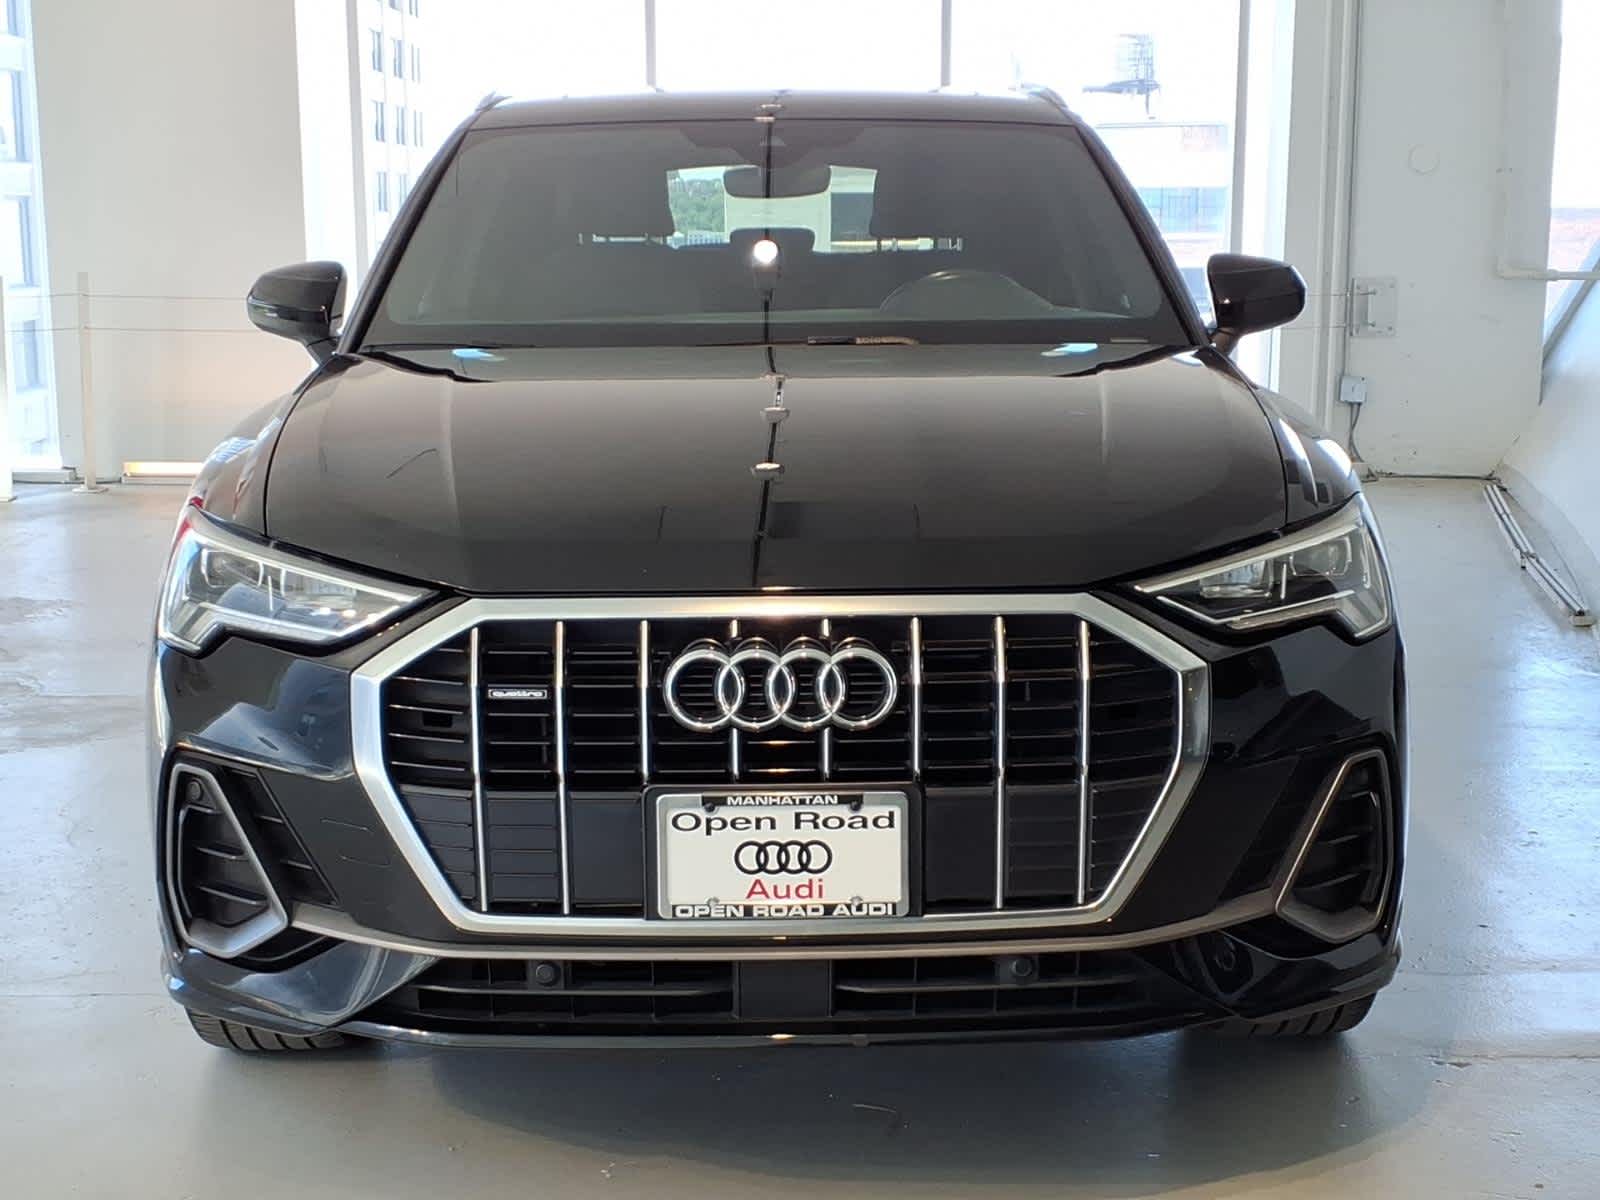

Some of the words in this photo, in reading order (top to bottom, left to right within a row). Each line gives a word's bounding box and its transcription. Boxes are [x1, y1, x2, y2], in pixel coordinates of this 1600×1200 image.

[727, 795, 838, 806] MANHATTAN
[672, 812, 777, 836] Open
[794, 811, 896, 830] Road
[746, 879, 824, 899] Audi
[675, 905, 745, 918] OPEN
[752, 904, 824, 917] ROAD
[831, 903, 893, 916] AUDI
